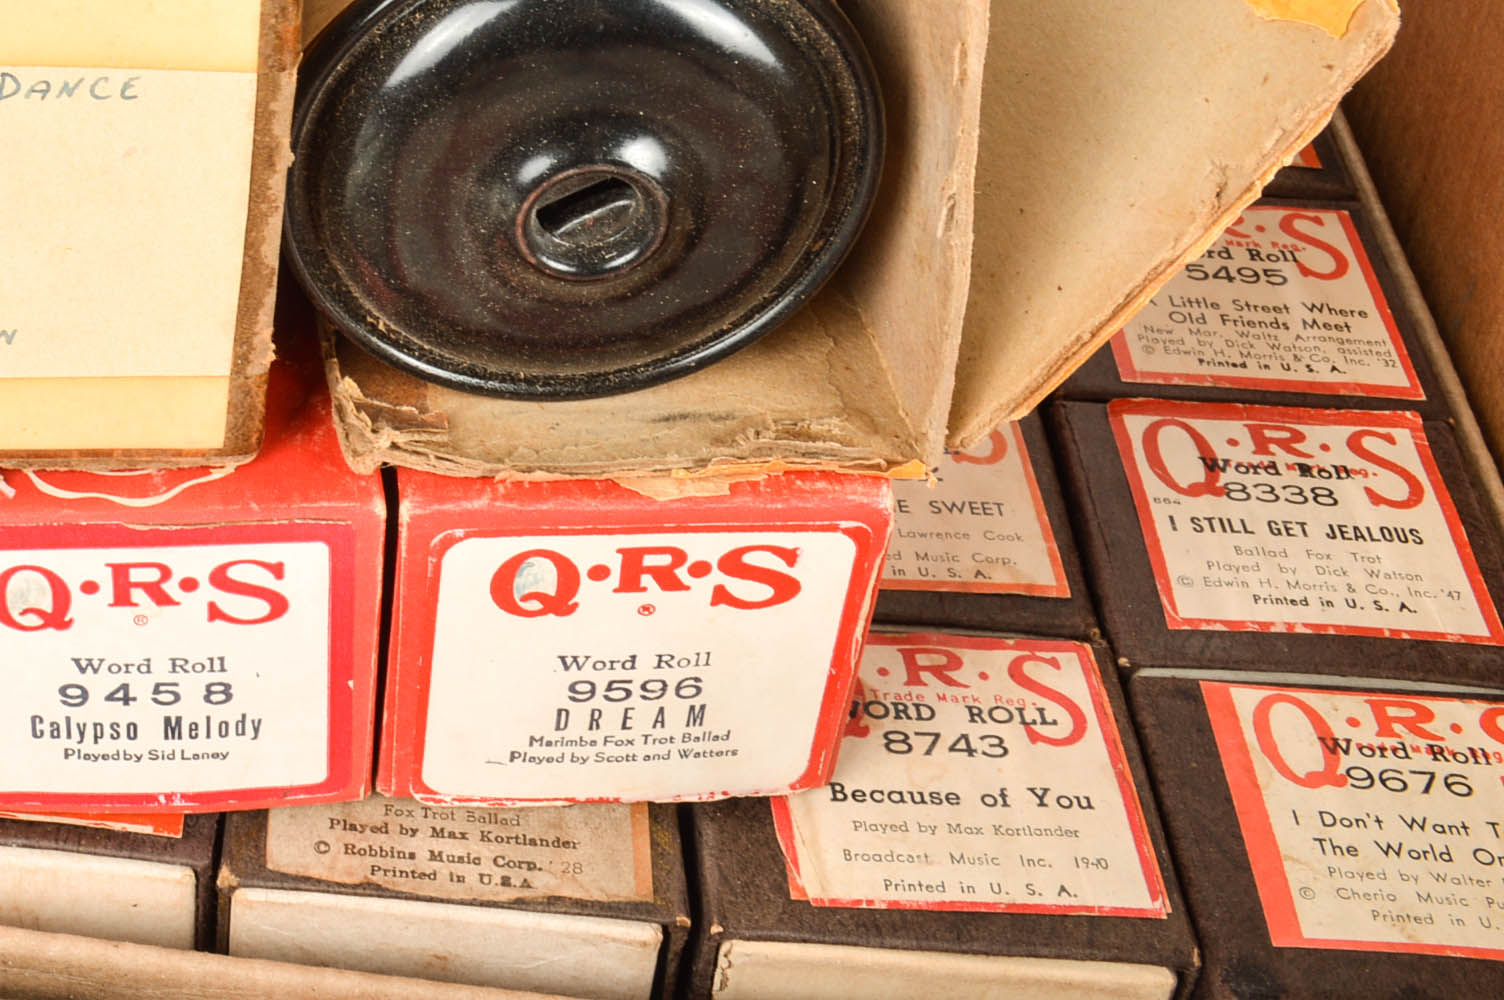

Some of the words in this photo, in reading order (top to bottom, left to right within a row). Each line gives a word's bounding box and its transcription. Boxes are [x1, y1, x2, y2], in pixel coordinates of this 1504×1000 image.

[1247, 247, 1299, 264] Roll
[1185, 264, 1288, 286] 5495
[1169, 295, 1220, 311] Little
[1232, 299, 1291, 314] Street
[1301, 302, 1368, 319] Where
[1169, 311, 1207, 325] Old
[1220, 315, 1290, 332] Friends
[1302, 318, 1352, 333] Meet
[1198, 457, 1283, 477] Word
[1224, 481, 1339, 507] 8338
[929, 500, 1005, 516] SWEET
[897, 528, 971, 541] Lawrence
[984, 530, 1024, 542] Cook
[1191, 517, 1256, 535] STILL
[1266, 521, 1310, 538] GET
[1326, 524, 1425, 545] JEALOUS
[915, 551, 960, 563] Music
[972, 552, 1017, 566] Corp.
[71, 656, 153, 675] Word
[168, 656, 228, 674] Roll
[557, 654, 637, 672] Word
[653, 651, 712, 669] Roll
[57, 681, 234, 708] 9458
[568, 677, 704, 703] 9596
[967, 705, 1058, 726] ROLL
[30, 714, 139, 745] Calypso
[164, 714, 263, 742] Melody
[529, 735, 598, 747] Marimba
[603, 735, 635, 747] Fox
[641, 734, 676, 745] Trot
[681, 730, 732, 743] Ballad
[64, 748, 120, 762] Played
[122, 749, 144, 762] by
[147, 748, 176, 761] Sid
[882, 730, 1010, 758] 8743
[1317, 736, 1413, 760] Word
[1425, 743, 1494, 766] Roll
[509, 751, 565, 764] Played
[570, 753, 589, 765] by
[594, 752, 638, 763] Scott
[643, 750, 671, 761] and
[678, 748, 739, 759] Watters
[1346, 765, 1474, 797] 9676
[828, 781, 962, 806] Because
[979, 787, 1009, 808] of
[1026, 787, 1095, 811] You
[383, 804, 416, 819] Fox
[421, 807, 456, 822] Trot
[1292, 809, 1301, 826] I
[1318, 810, 1385, 831] Don't
[1399, 813, 1471, 837] Want
[328, 818, 390, 836] Played
[399, 825, 420, 838] by
[430, 826, 470, 841] Max
[479, 830, 582, 851] Kortlander
[852, 819, 910, 836] Played
[916, 822, 938, 837] by
[946, 822, 985, 836] Max
[992, 823, 1081, 839] Kortlander
[343, 843, 418, 861] Robbins
[428, 849, 482, 866] Music
[493, 856, 544, 872] Corp.
[842, 849, 930, 865] Broadcast
[948, 852, 1001, 867] Music
[1020, 854, 1053, 869] Inc.
[1313, 837, 1360, 858] The
[1373, 840, 1454, 864] World
[370, 865, 438, 881] Printed
[449, 873, 467, 884] in
[1327, 865, 1388, 882] Played
[1399, 871, 1420, 885] by
[1429, 871, 1493, 888] Walter
[883, 878, 947, 895] Printed
[959, 880, 977, 895] in
[1336, 887, 1398, 903] Cherio
[1416, 890, 1470, 909] Music
[1371, 909, 1435, 926] Printed
[1448, 913, 1466, 927] in
